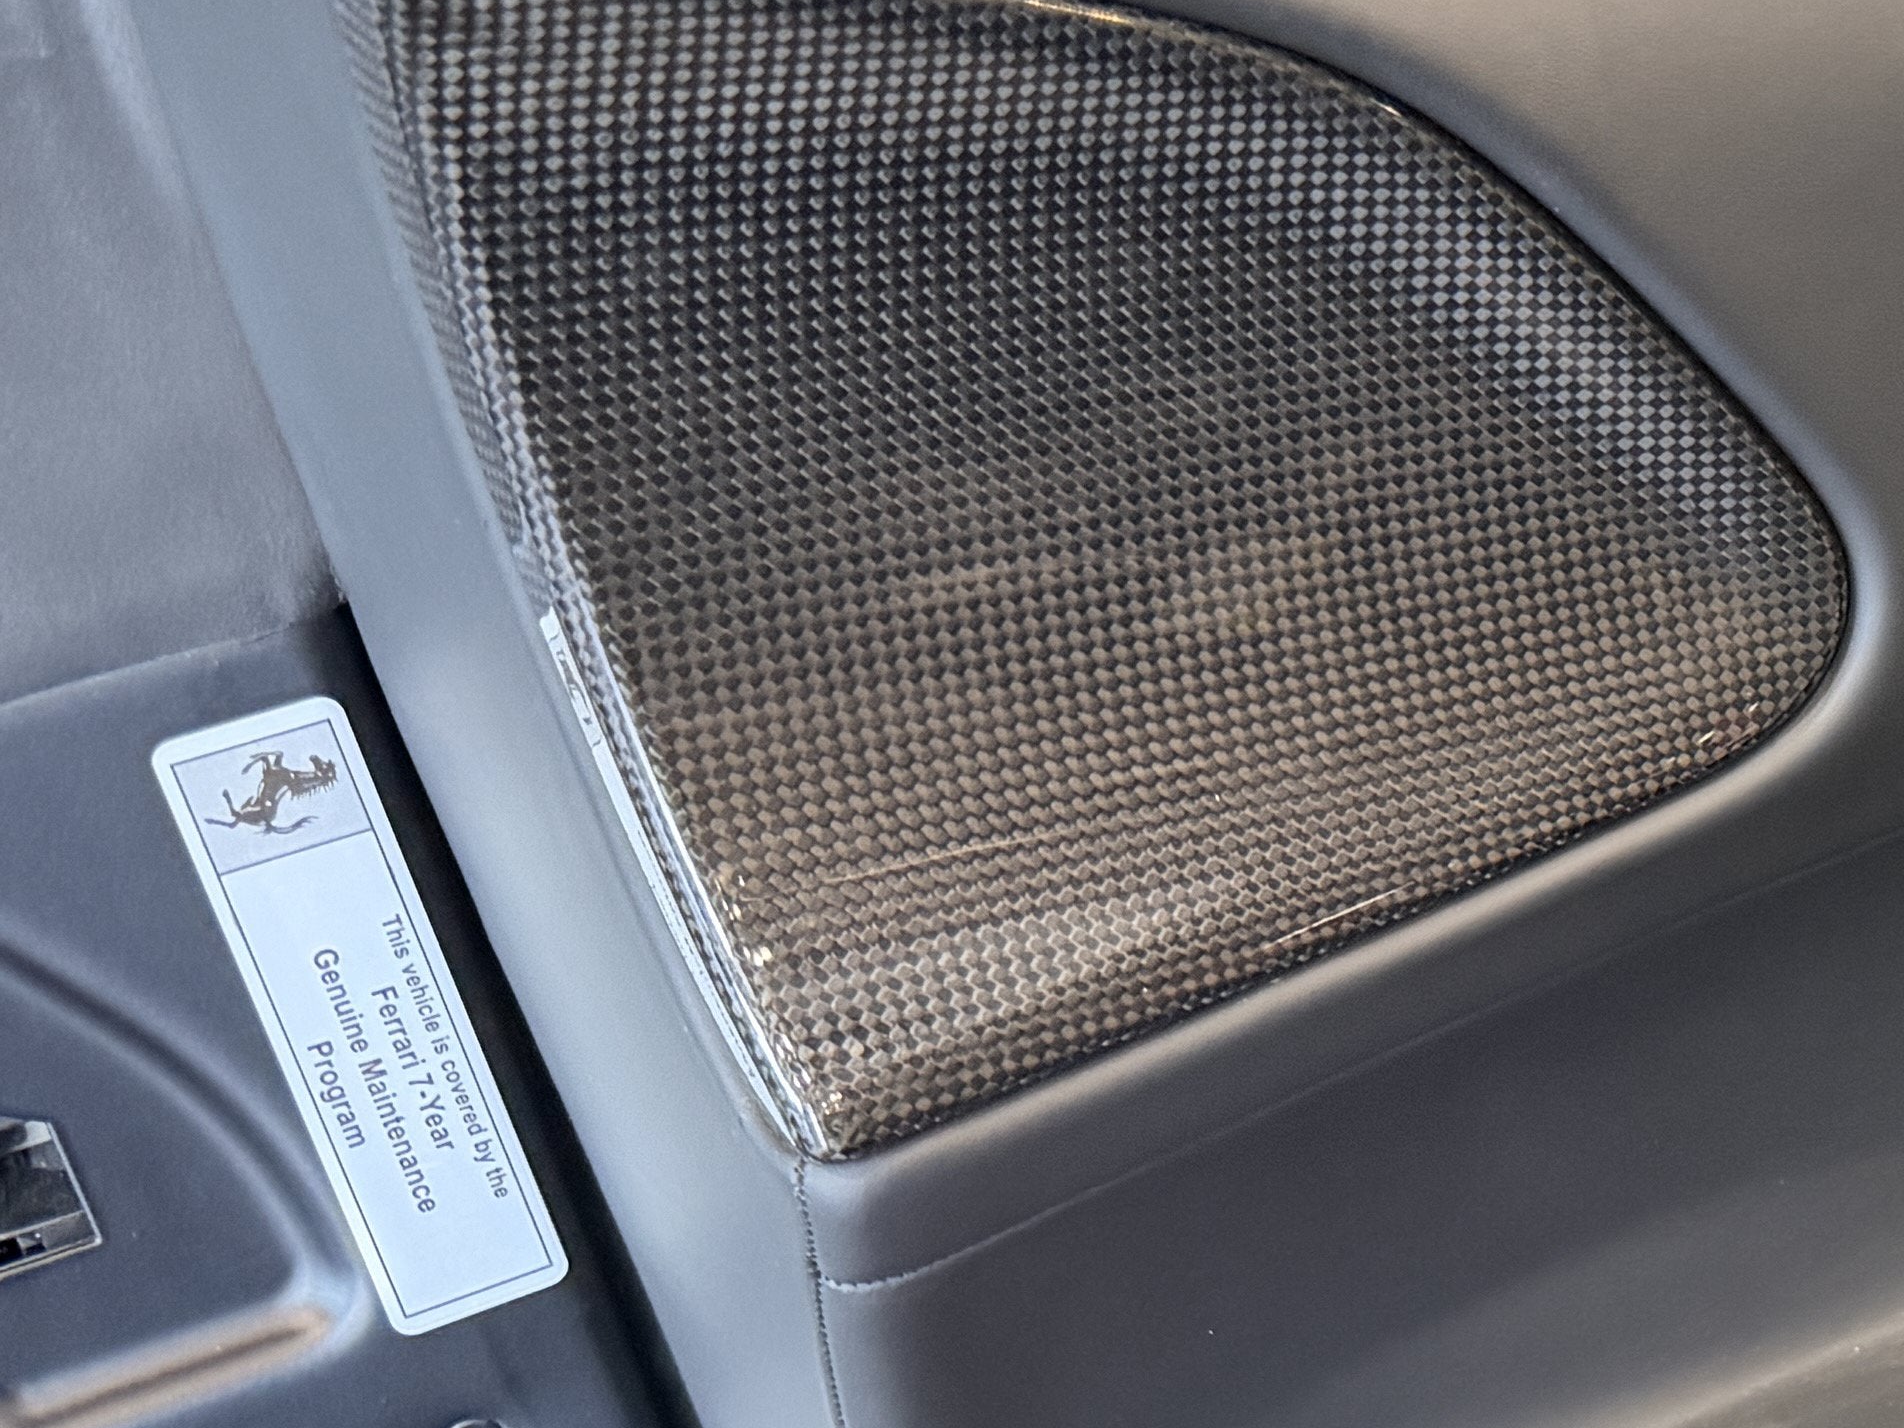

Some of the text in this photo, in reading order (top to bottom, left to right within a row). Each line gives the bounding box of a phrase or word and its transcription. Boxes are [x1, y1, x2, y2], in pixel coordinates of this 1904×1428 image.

[305, 1039, 366, 1149] Program
[312, 947, 437, 1214] Genuine Maintenance
[369, 983, 455, 1150] Ferrari 7-Year
[380, 911, 509, 1199] This vehicle is covered by the
